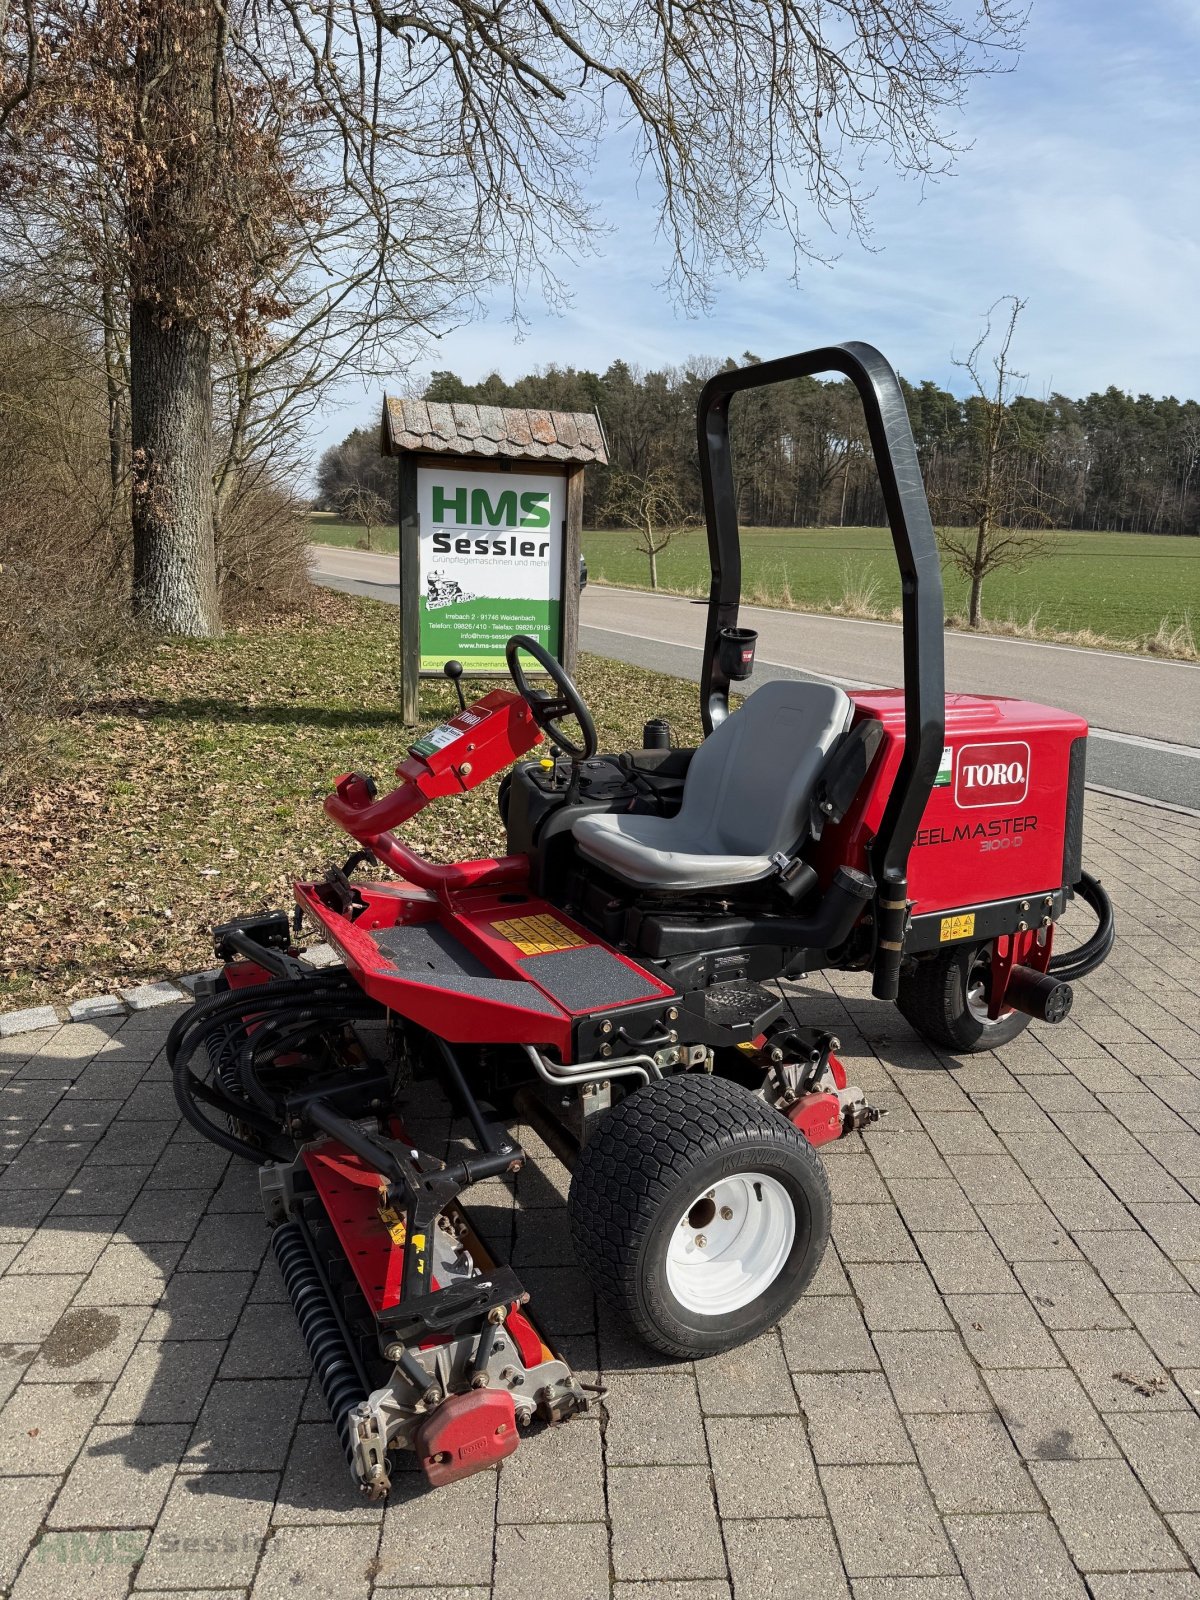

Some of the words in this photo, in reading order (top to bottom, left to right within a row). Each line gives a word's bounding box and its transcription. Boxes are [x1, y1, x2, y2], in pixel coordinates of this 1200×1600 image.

[432, 485, 551, 529] HMS
[432, 532, 550, 557] Sessler
[432, 555, 512, 566] Grünpflegemaschinen
[514, 558, 529, 566] und
[912, 815, 1038, 847] EELMASTER
[720, 1148, 789, 1174] KENDA
